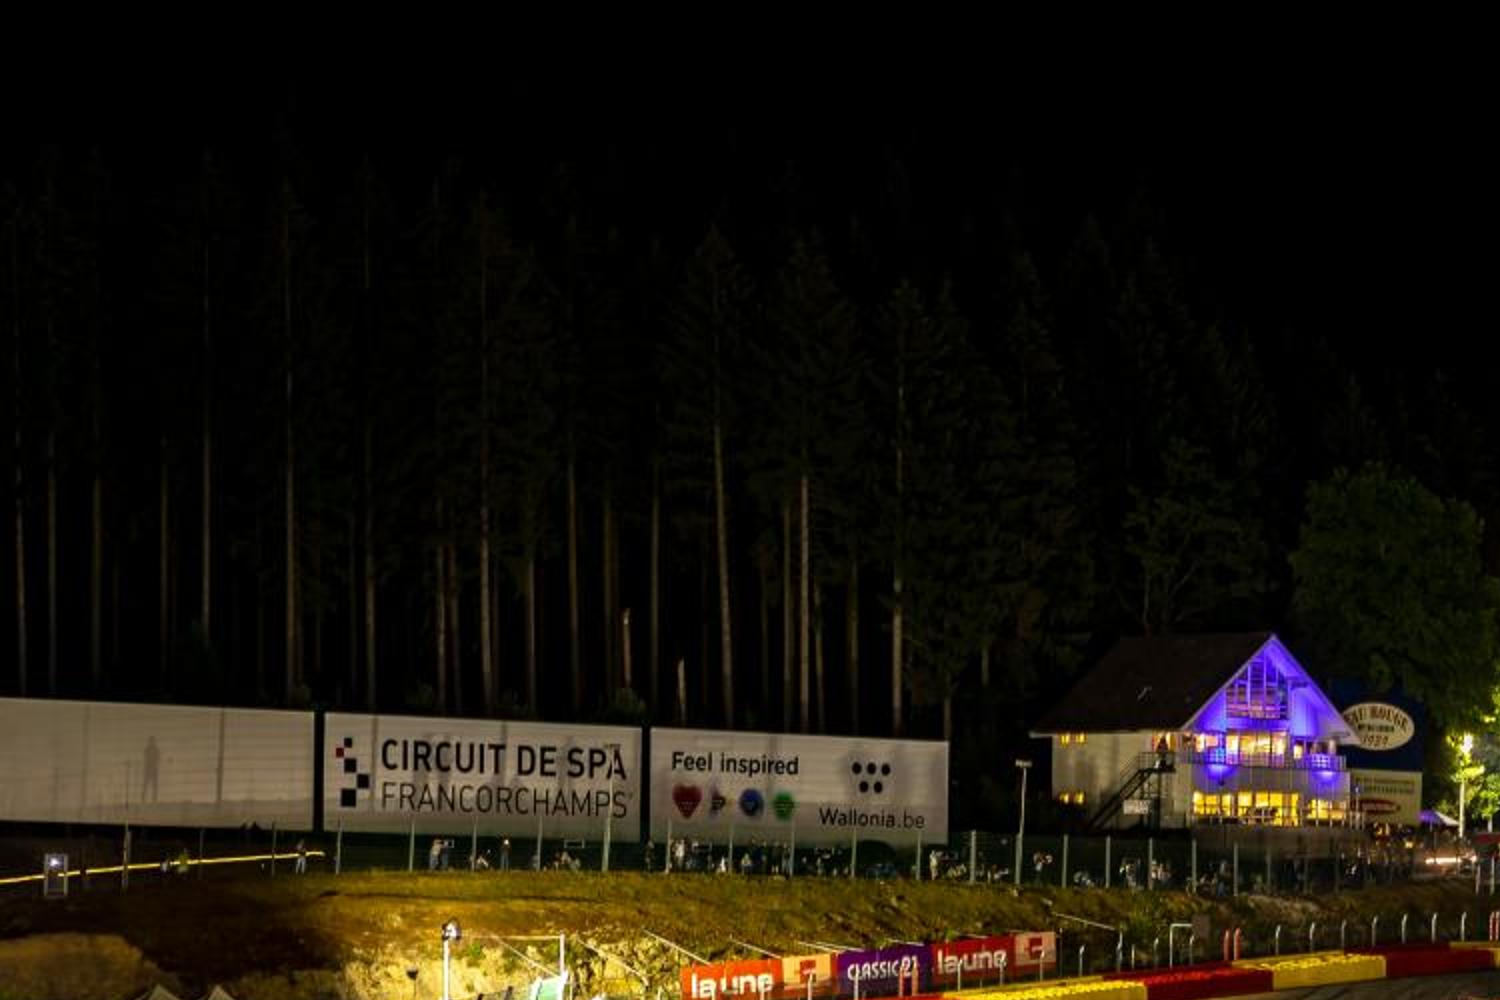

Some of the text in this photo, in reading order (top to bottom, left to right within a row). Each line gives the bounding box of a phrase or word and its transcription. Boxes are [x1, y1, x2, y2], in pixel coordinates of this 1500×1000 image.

[381, 738, 627, 780] CIRCUIT DE SPA
[672, 751, 799, 778] Feel inspired
[381, 782, 627, 819] FRANCORCHAMPS
[819, 808, 925, 829] Wallonia.be
[691, 970, 773, 999] la une
[847, 961, 900, 980] CLASSIC
